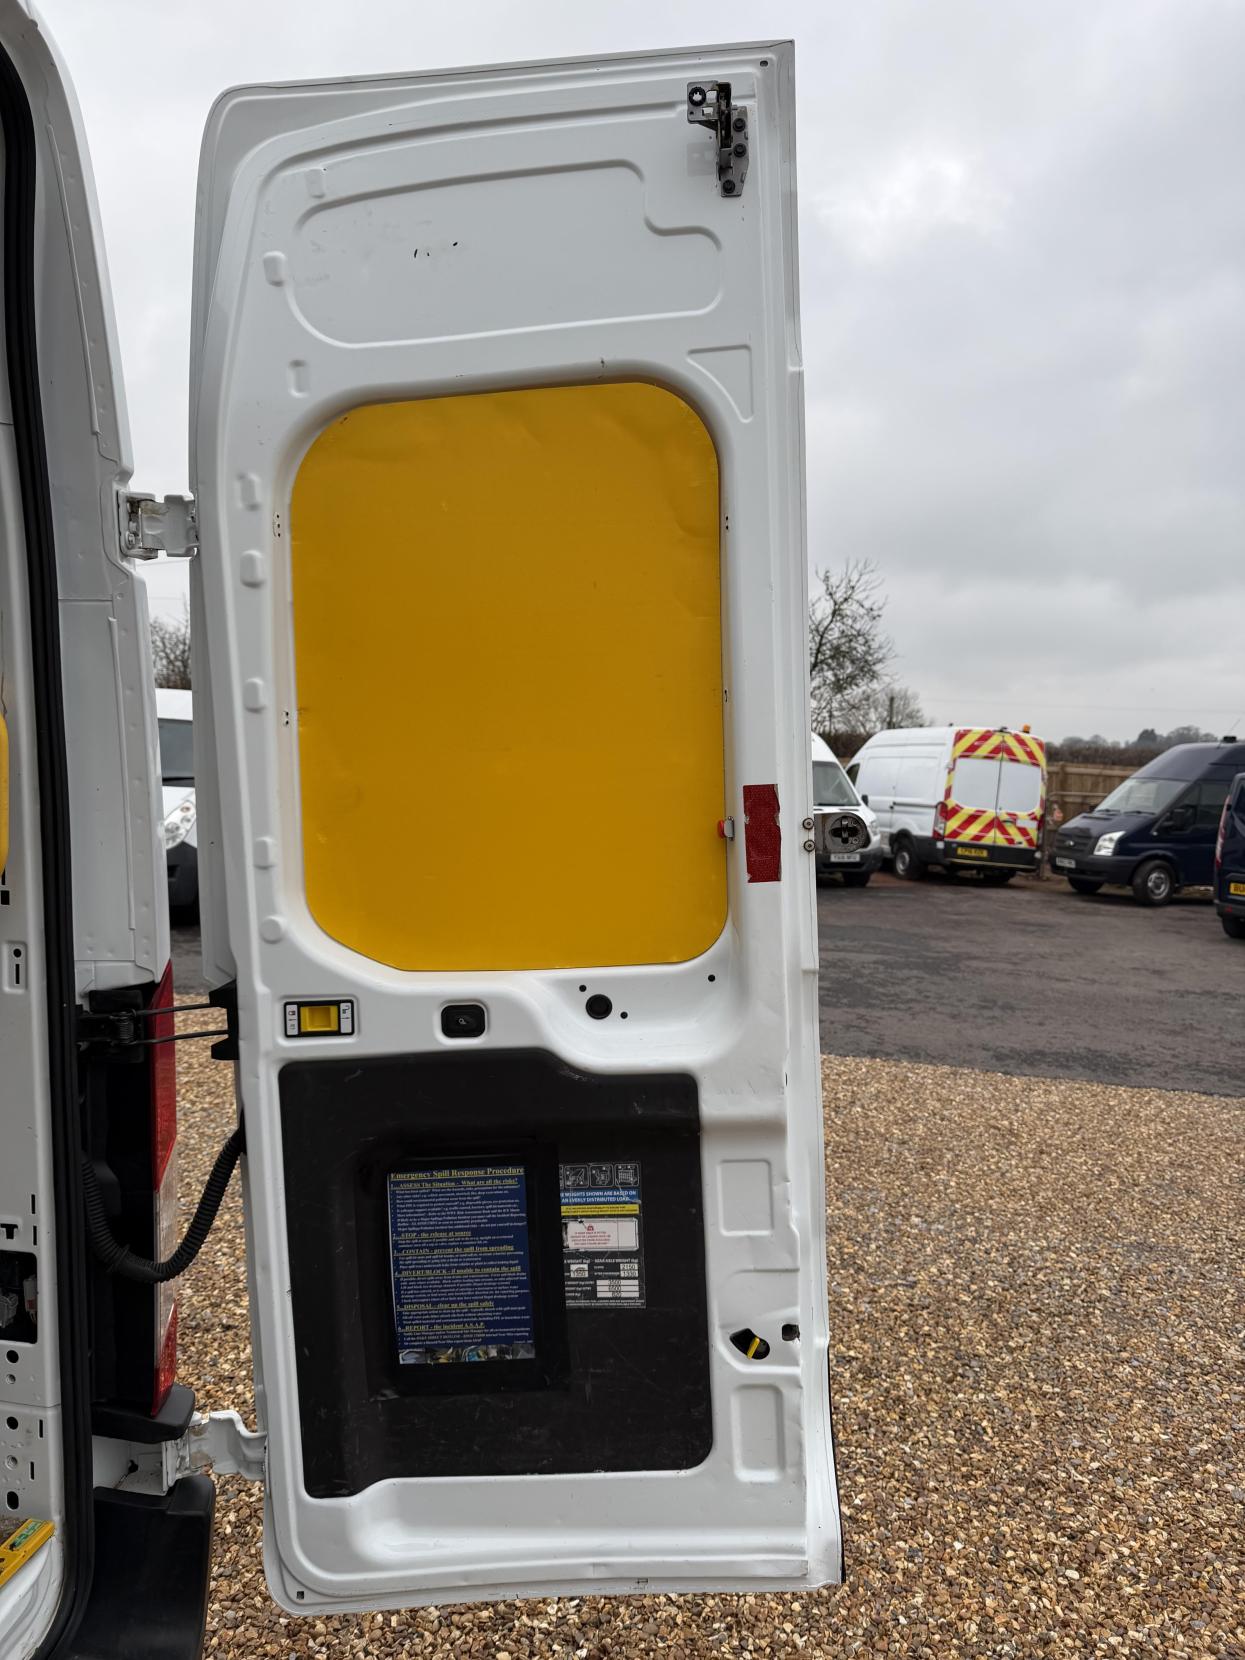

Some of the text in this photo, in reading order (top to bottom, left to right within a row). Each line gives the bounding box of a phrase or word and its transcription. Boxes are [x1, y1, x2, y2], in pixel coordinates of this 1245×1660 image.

[391, 1166, 524, 1180] Emergency Spill Response Procedure
